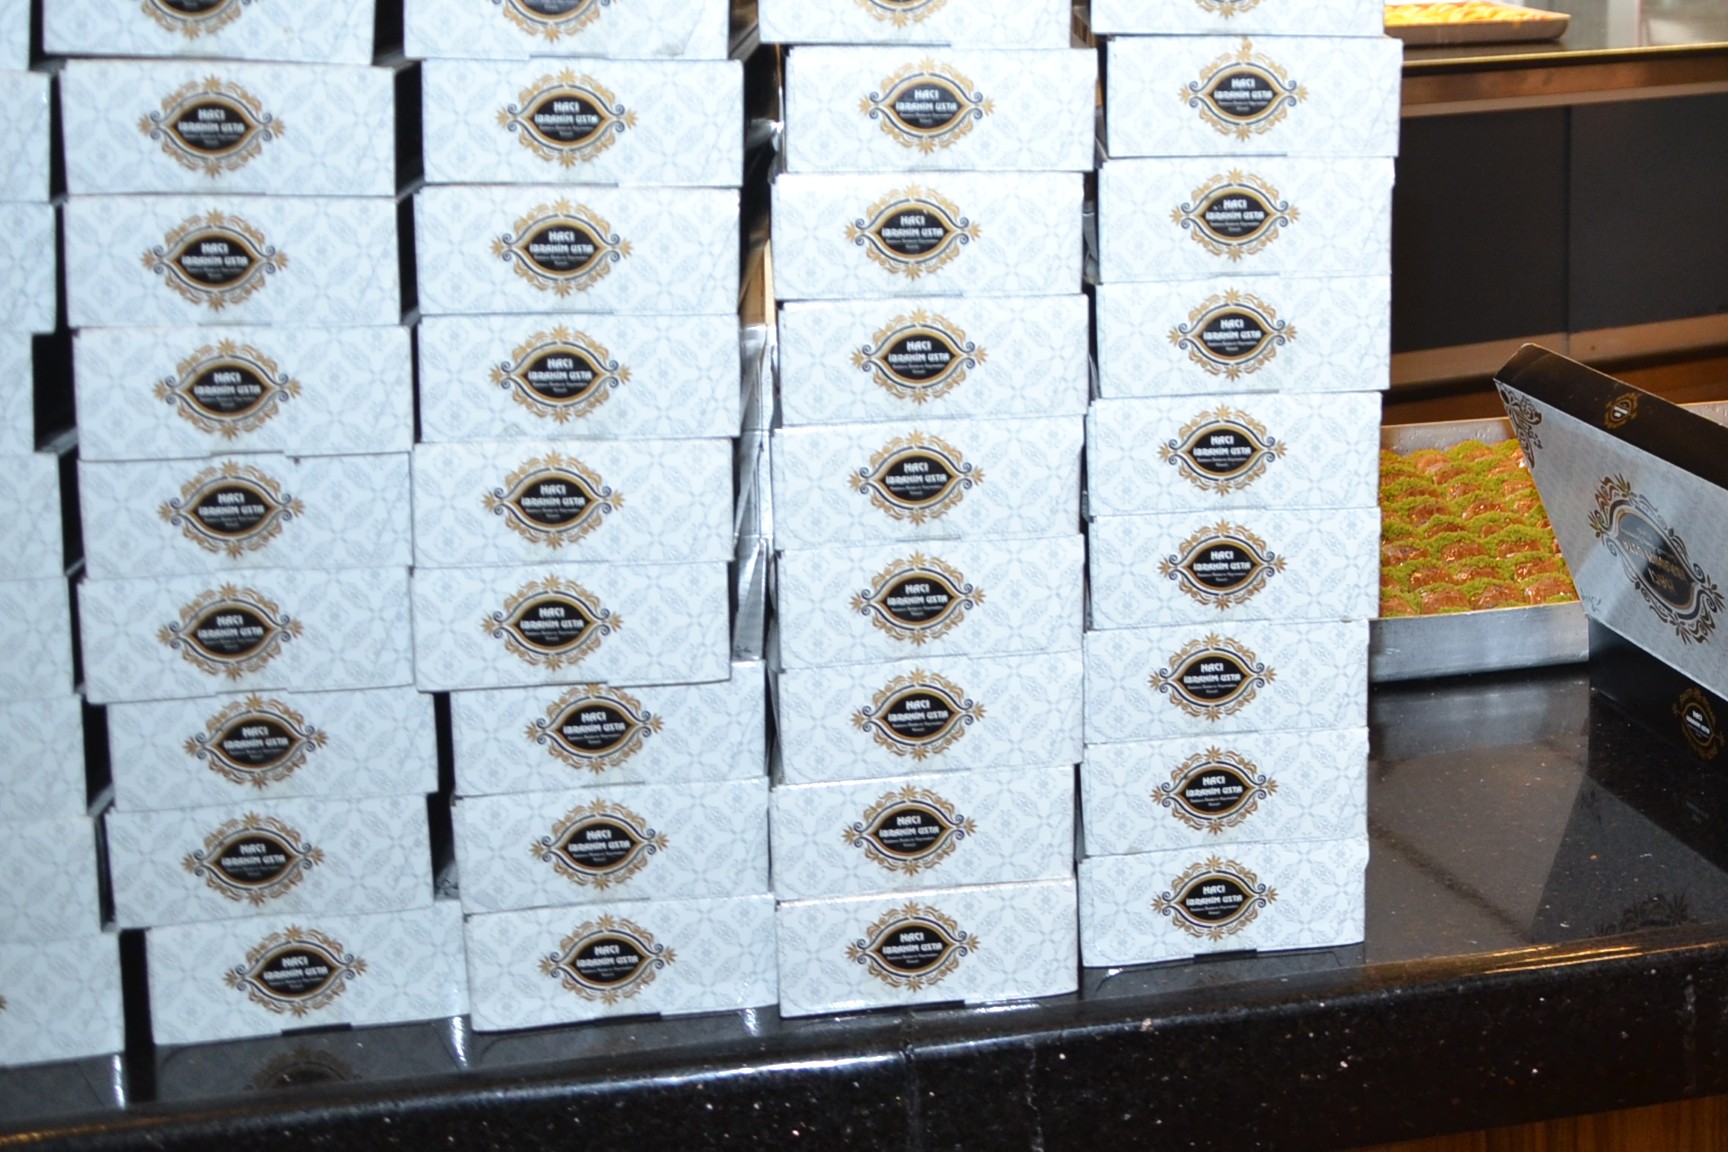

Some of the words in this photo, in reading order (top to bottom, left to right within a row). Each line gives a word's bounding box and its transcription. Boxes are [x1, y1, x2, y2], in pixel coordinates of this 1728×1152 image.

[1232, 79, 1255, 88] HACI
[915, 90, 939, 100] HACI
[554, 103, 579, 112] HACI
[936, 103, 957, 111] USTA
[198, 110, 225, 120] HACI
[576, 115, 598, 123] USTA
[221, 123, 245, 132] USTA
[1224, 200, 1247, 209] HACI
[901, 217, 925, 226] HACI
[922, 228, 943, 236] USTA
[549, 232, 574, 242] HACI
[202, 244, 228, 253] HACI
[571, 245, 593, 253] USTA
[225, 257, 248, 265] USTA
[1221, 320, 1244, 329] HACI
[1241, 331, 1261, 339] USTA
[907, 342, 931, 351] HACI
[928, 353, 950, 361] USTA
[547, 359, 573, 369] HACI
[214, 373, 241, 383] HACI
[570, 371, 592, 379] USTA
[237, 385, 261, 394] USTA
[1211, 436, 1234, 445] HACI
[1231, 447, 1251, 455] USTA
[904, 463, 928, 473] HACI
[925, 474, 947, 482] USTA
[540, 485, 566, 495] HACI
[218, 494, 244, 504] HACI
[563, 497, 585, 505] USTA
[241, 505, 265, 514] USTA
[1211, 551, 1234, 560] HACI
[1231, 562, 1251, 570] USTA
[905, 584, 929, 594] HACI
[926, 595, 948, 603] USTA
[539, 608, 564, 618] HACI
[217, 616, 243, 626] HACI
[561, 620, 584, 628] USTA
[240, 627, 263, 636] USTA
[1201, 663, 1224, 673] HACI
[1221, 673, 1241, 681] USTA
[906, 700, 930, 710] HACI
[581, 712, 606, 722] HACI
[927, 710, 948, 719] USTA
[603, 723, 626, 731] USTA
[242, 727, 269, 737] HACI
[265, 737, 289, 746] USTA
[1203, 776, 1225, 786] HACI
[1222, 786, 1243, 794] USTA
[897, 816, 921, 826] HACI
[918, 826, 939, 834] USTA
[586, 830, 611, 840] HACI
[240, 844, 266, 854] HACI
[608, 840, 630, 849] USTA
[263, 855, 286, 863] USTA
[1203, 885, 1225, 895] HACI
[1223, 894, 1243, 903] USTA
[900, 932, 924, 942] HACI
[594, 945, 619, 955] HACI
[921, 942, 943, 951] USTA
[282, 956, 308, 967] HACI
[616, 955, 638, 964] USTA
[305, 966, 328, 976] USTA
